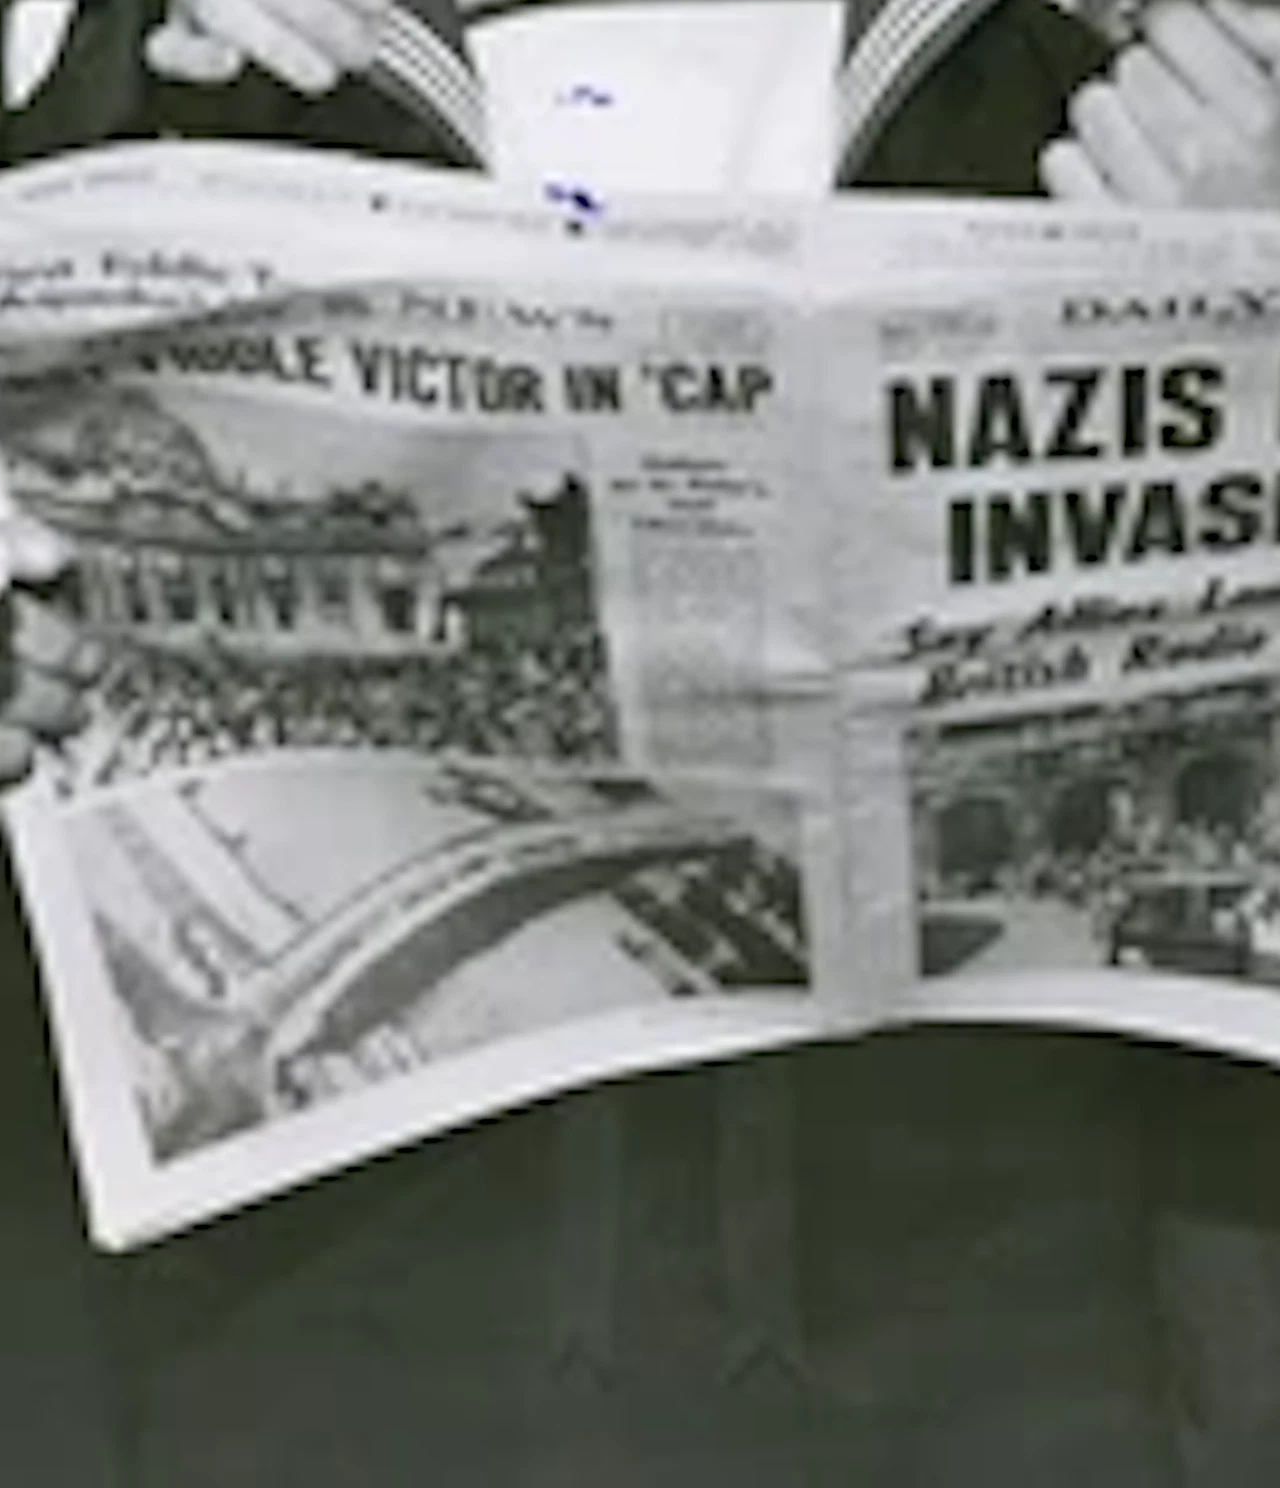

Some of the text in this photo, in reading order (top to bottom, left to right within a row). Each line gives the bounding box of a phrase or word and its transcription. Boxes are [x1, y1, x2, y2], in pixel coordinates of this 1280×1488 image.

[352, 338, 549, 414] VICTOR
[562, 363, 626, 413] IN
[885, 360, 1228, 475] NAZIS
[1121, 622, 1268, 674] Radio
